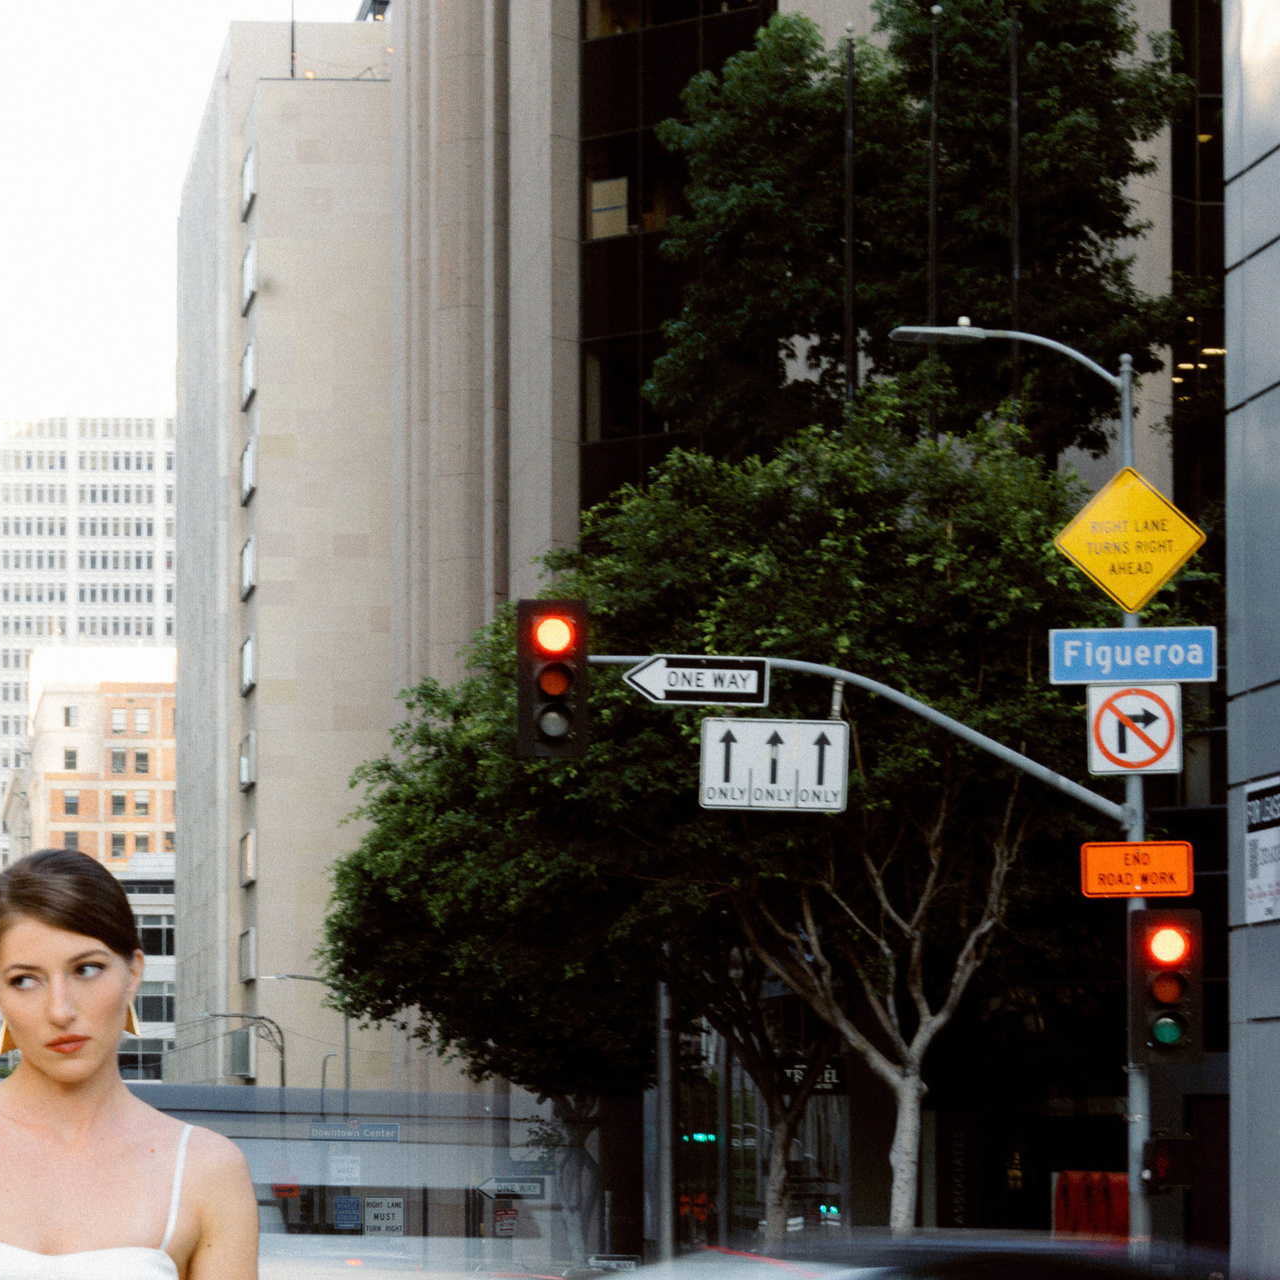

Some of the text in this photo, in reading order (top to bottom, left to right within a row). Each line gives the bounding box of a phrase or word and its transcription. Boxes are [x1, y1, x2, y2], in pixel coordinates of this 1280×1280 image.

[1090, 519, 1168, 534] RIGHT LANE
[1086, 540, 1174, 555] TURNS RIGHT
[1109, 561, 1153, 575] AHEAD
[1063, 640, 1204, 675] Figueroa
[668, 671, 751, 688] ONE WAY
[706, 786, 840, 802] ONLY ONLY ONLY
[1124, 853, 1151, 866] END
[1098, 872, 1177, 886] ROAD WORK
[783, 1069, 840, 1084] TREL
[311, 1128, 396, 1138] Downtown Center
[496, 1183, 537, 1193] ONE WAY
[373, 1212, 396, 1221] MUST
[385, 1224, 403, 1232] RIGHT
